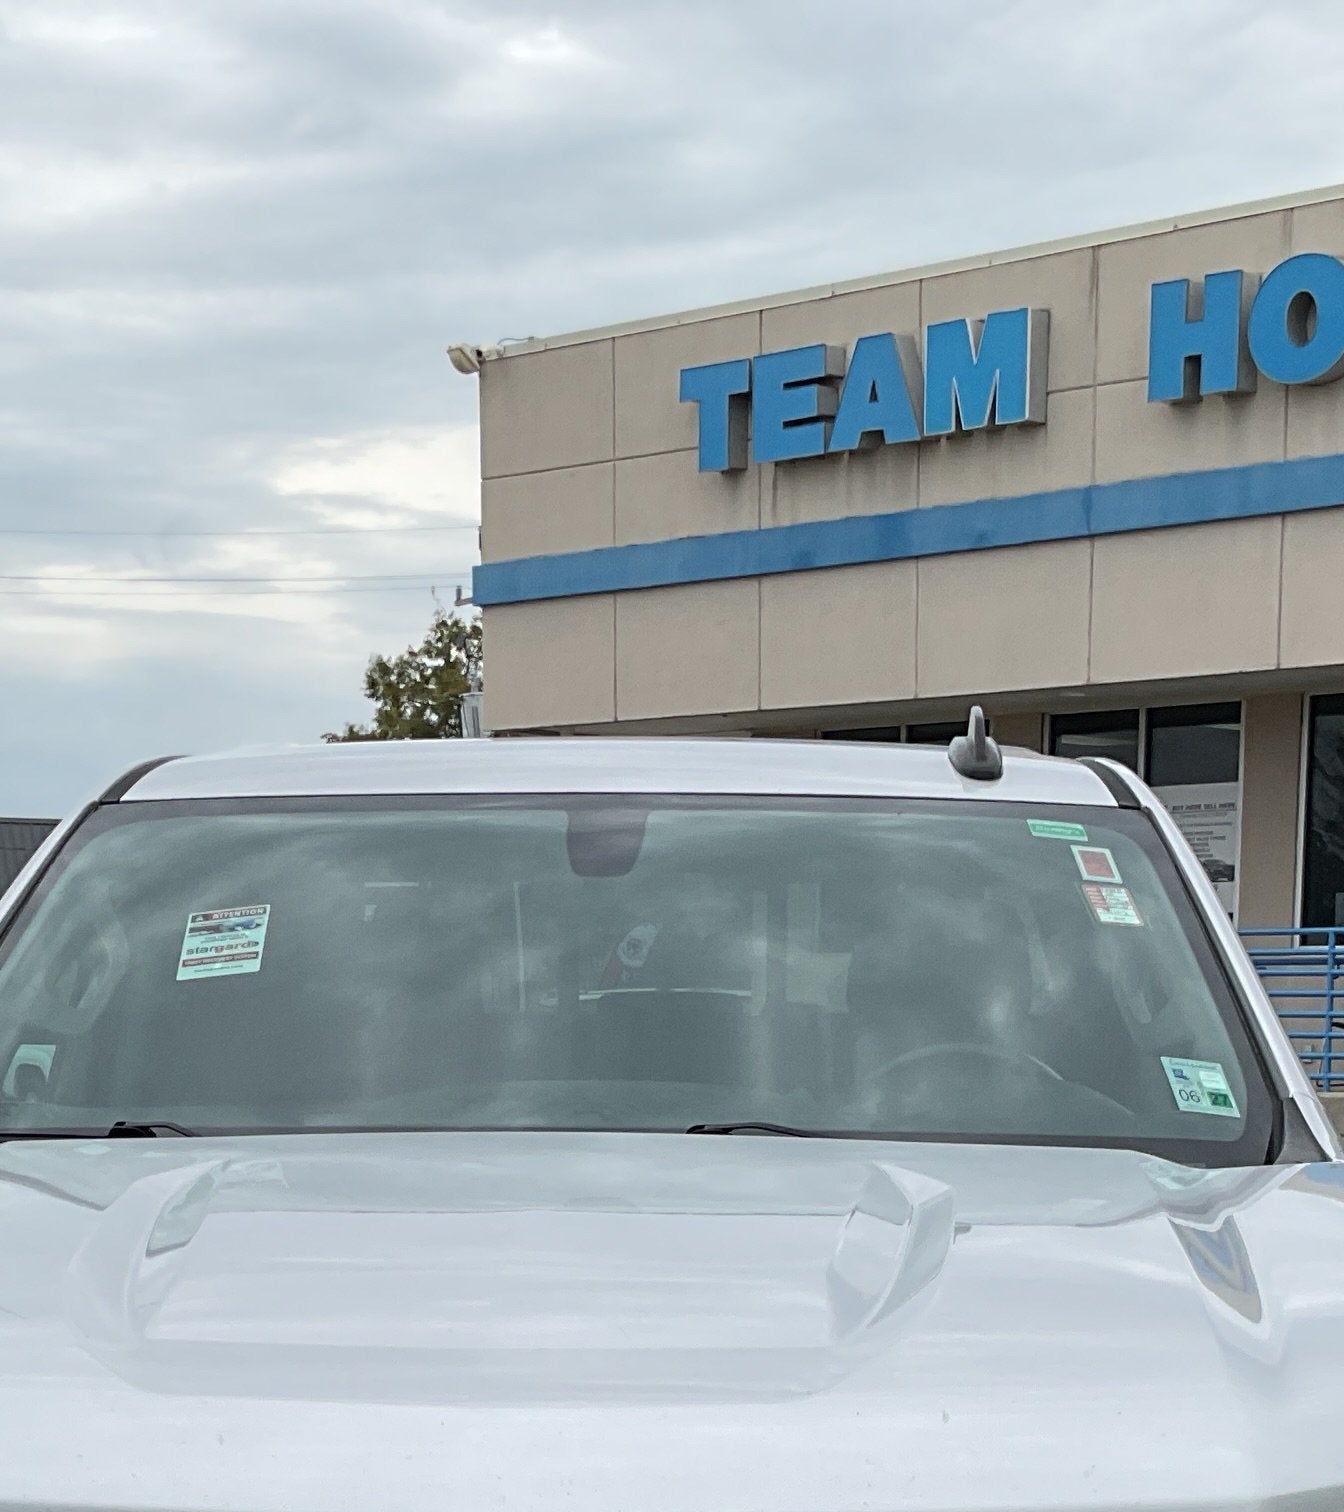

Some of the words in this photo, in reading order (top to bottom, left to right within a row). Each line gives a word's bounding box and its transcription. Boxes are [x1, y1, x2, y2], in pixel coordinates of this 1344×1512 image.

[679, 307, 1046, 473] TEAM
[212, 907, 265, 919] ATTENTION
[1178, 1089, 1201, 1103] 06
